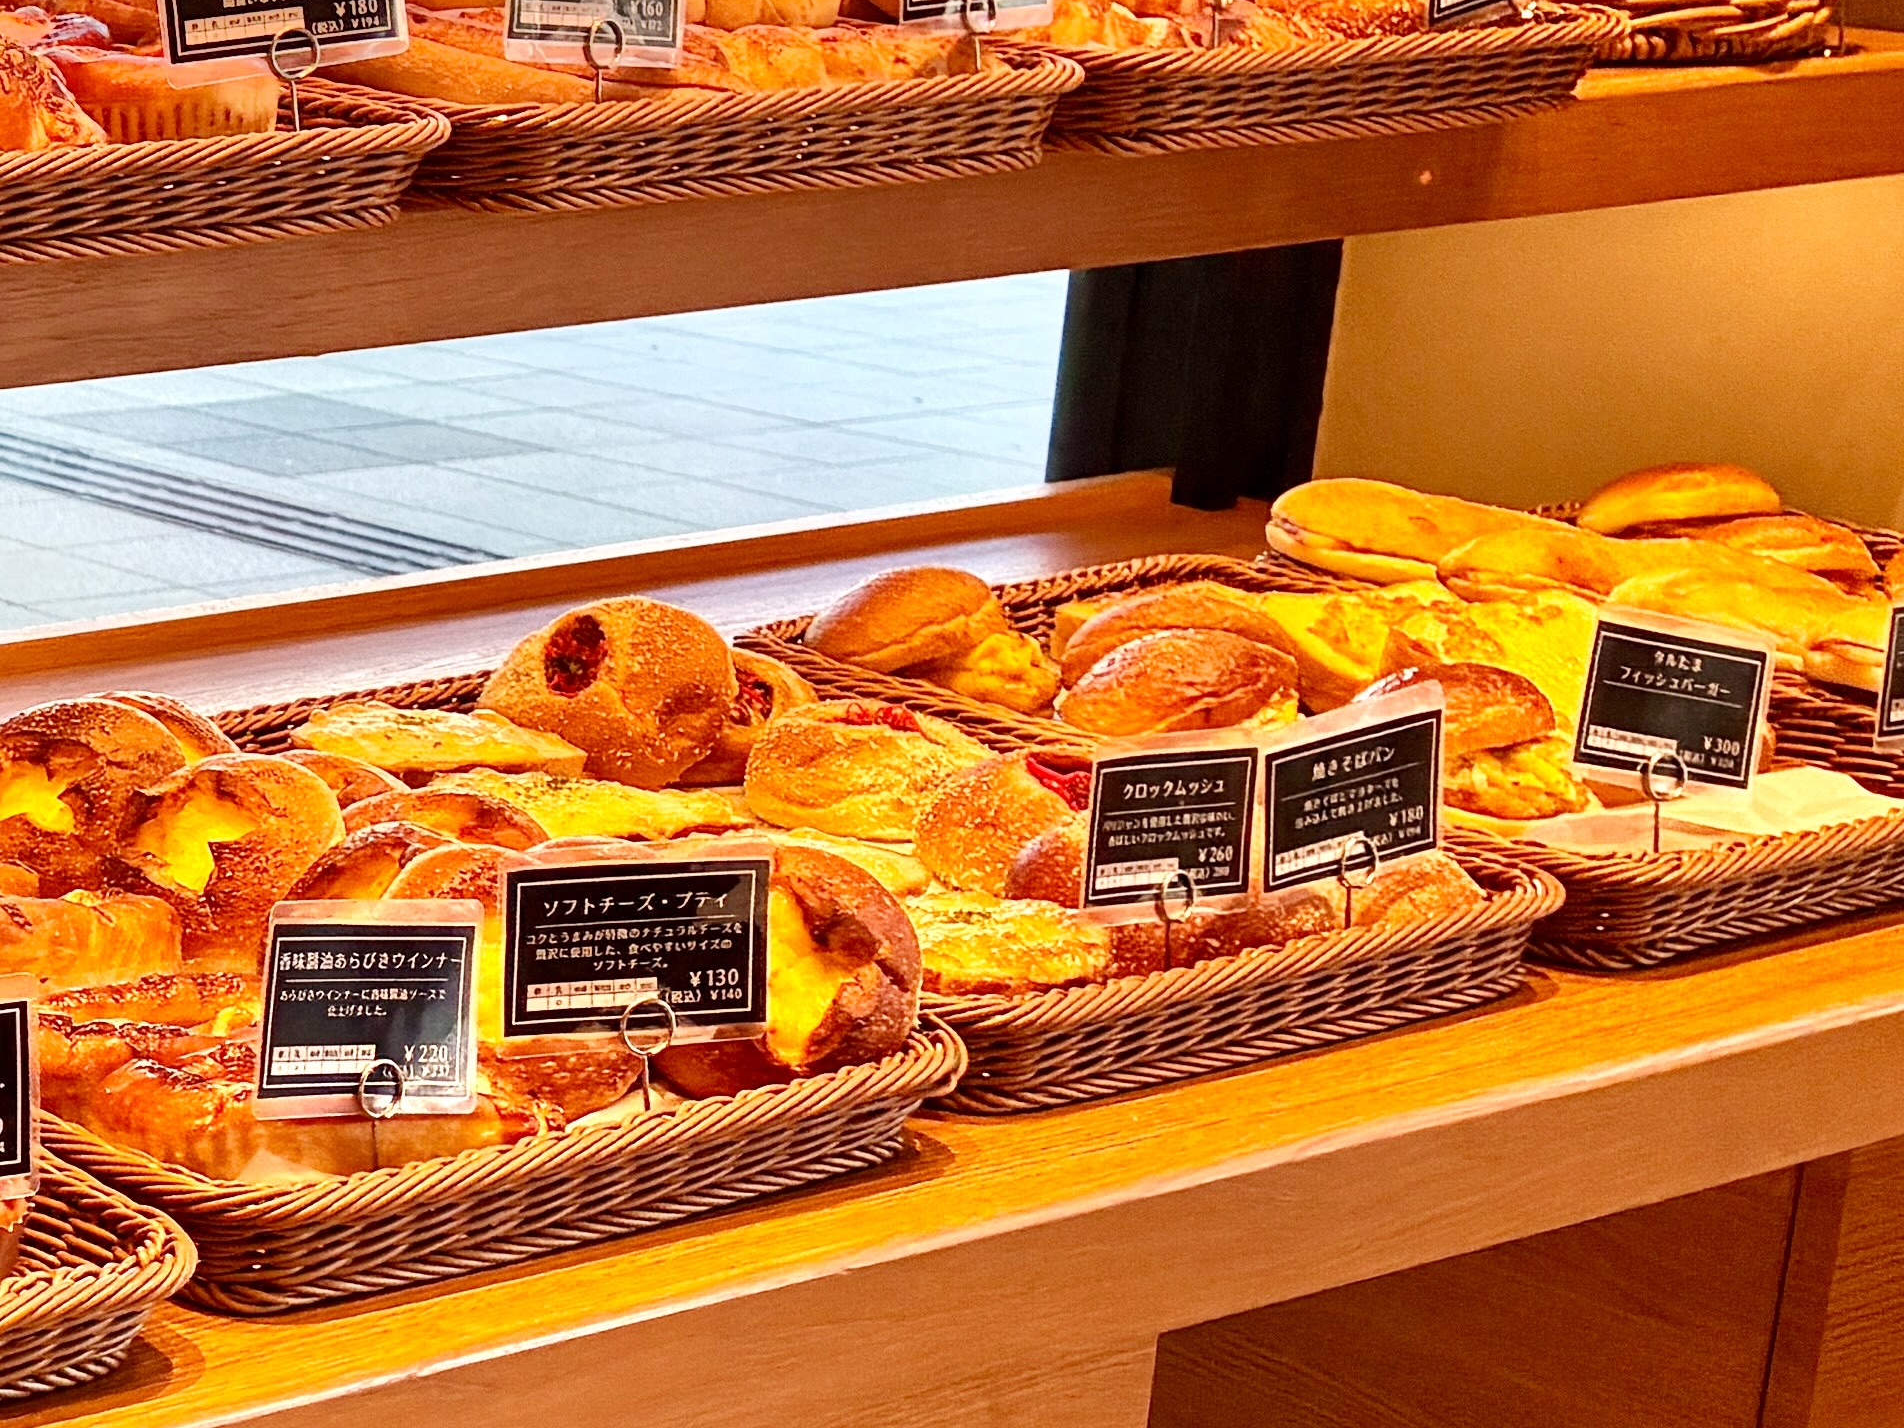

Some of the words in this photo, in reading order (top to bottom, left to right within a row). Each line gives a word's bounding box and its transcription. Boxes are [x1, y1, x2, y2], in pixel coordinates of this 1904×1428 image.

[1619, 665, 1732, 698] フィッシュバーガー
[1703, 735, 1741, 756] ¥300
[1312, 746, 1395, 782] 焼きそばパン
[1123, 778, 1225, 800] クロックムッシュ
[1389, 805, 1424, 826] ¥180
[1198, 845, 1234, 863] ¥260
[279, 951, 463, 971] 香味醤油あらびきウインナー
[593, 957, 668, 972] ソフトチーズ。
[689, 968, 739, 988] ¥130
[710, 987, 743, 1001] ¥140
[405, 1044, 449, 1063] ¥220
